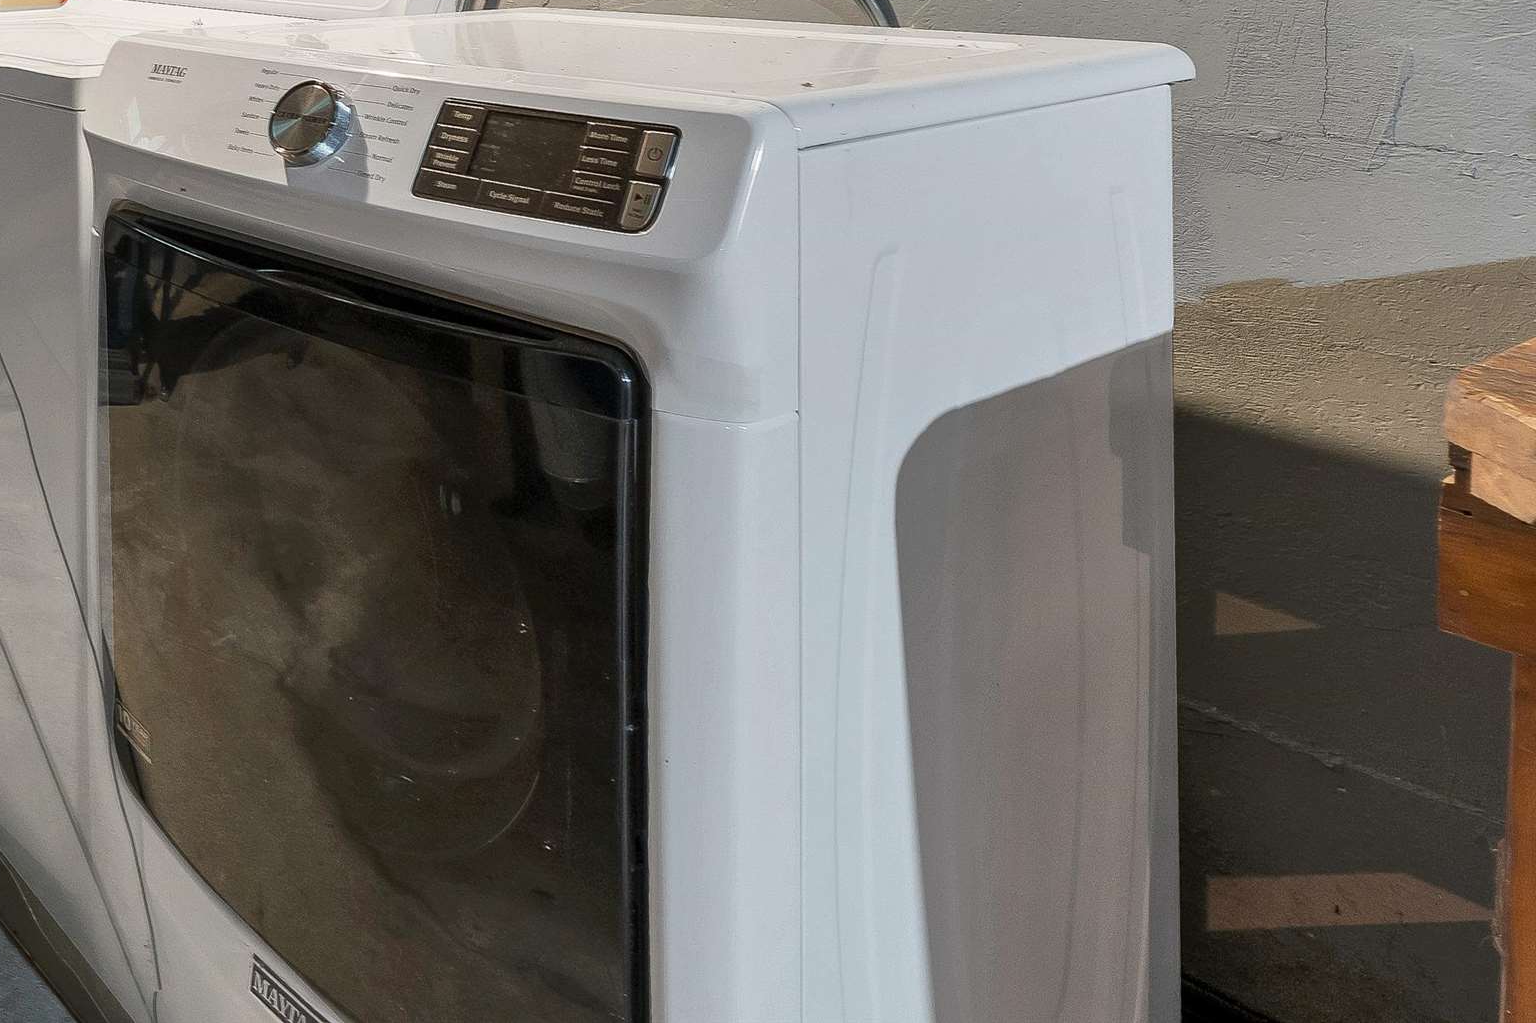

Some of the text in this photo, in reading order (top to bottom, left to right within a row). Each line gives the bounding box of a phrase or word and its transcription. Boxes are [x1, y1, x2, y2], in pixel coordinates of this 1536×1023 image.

[150, 63, 188, 78] MAYTAG
[391, 85, 421, 95] Quick Dry
[386, 101, 415, 111] Delicates
[364, 113, 409, 126] Wrinkle Control
[454, 110, 473, 121] Temp
[440, 131, 469, 143] Dryness
[589, 131, 629, 143] More Time
[581, 155, 618, 167] Less Time
[374, 173, 386, 183] Dry
[575, 177, 602, 188] Control
[603, 182, 622, 190] Lock
[489, 190, 531, 205] Cycle Signal
[553, 201, 604, 217] Reduce Static
